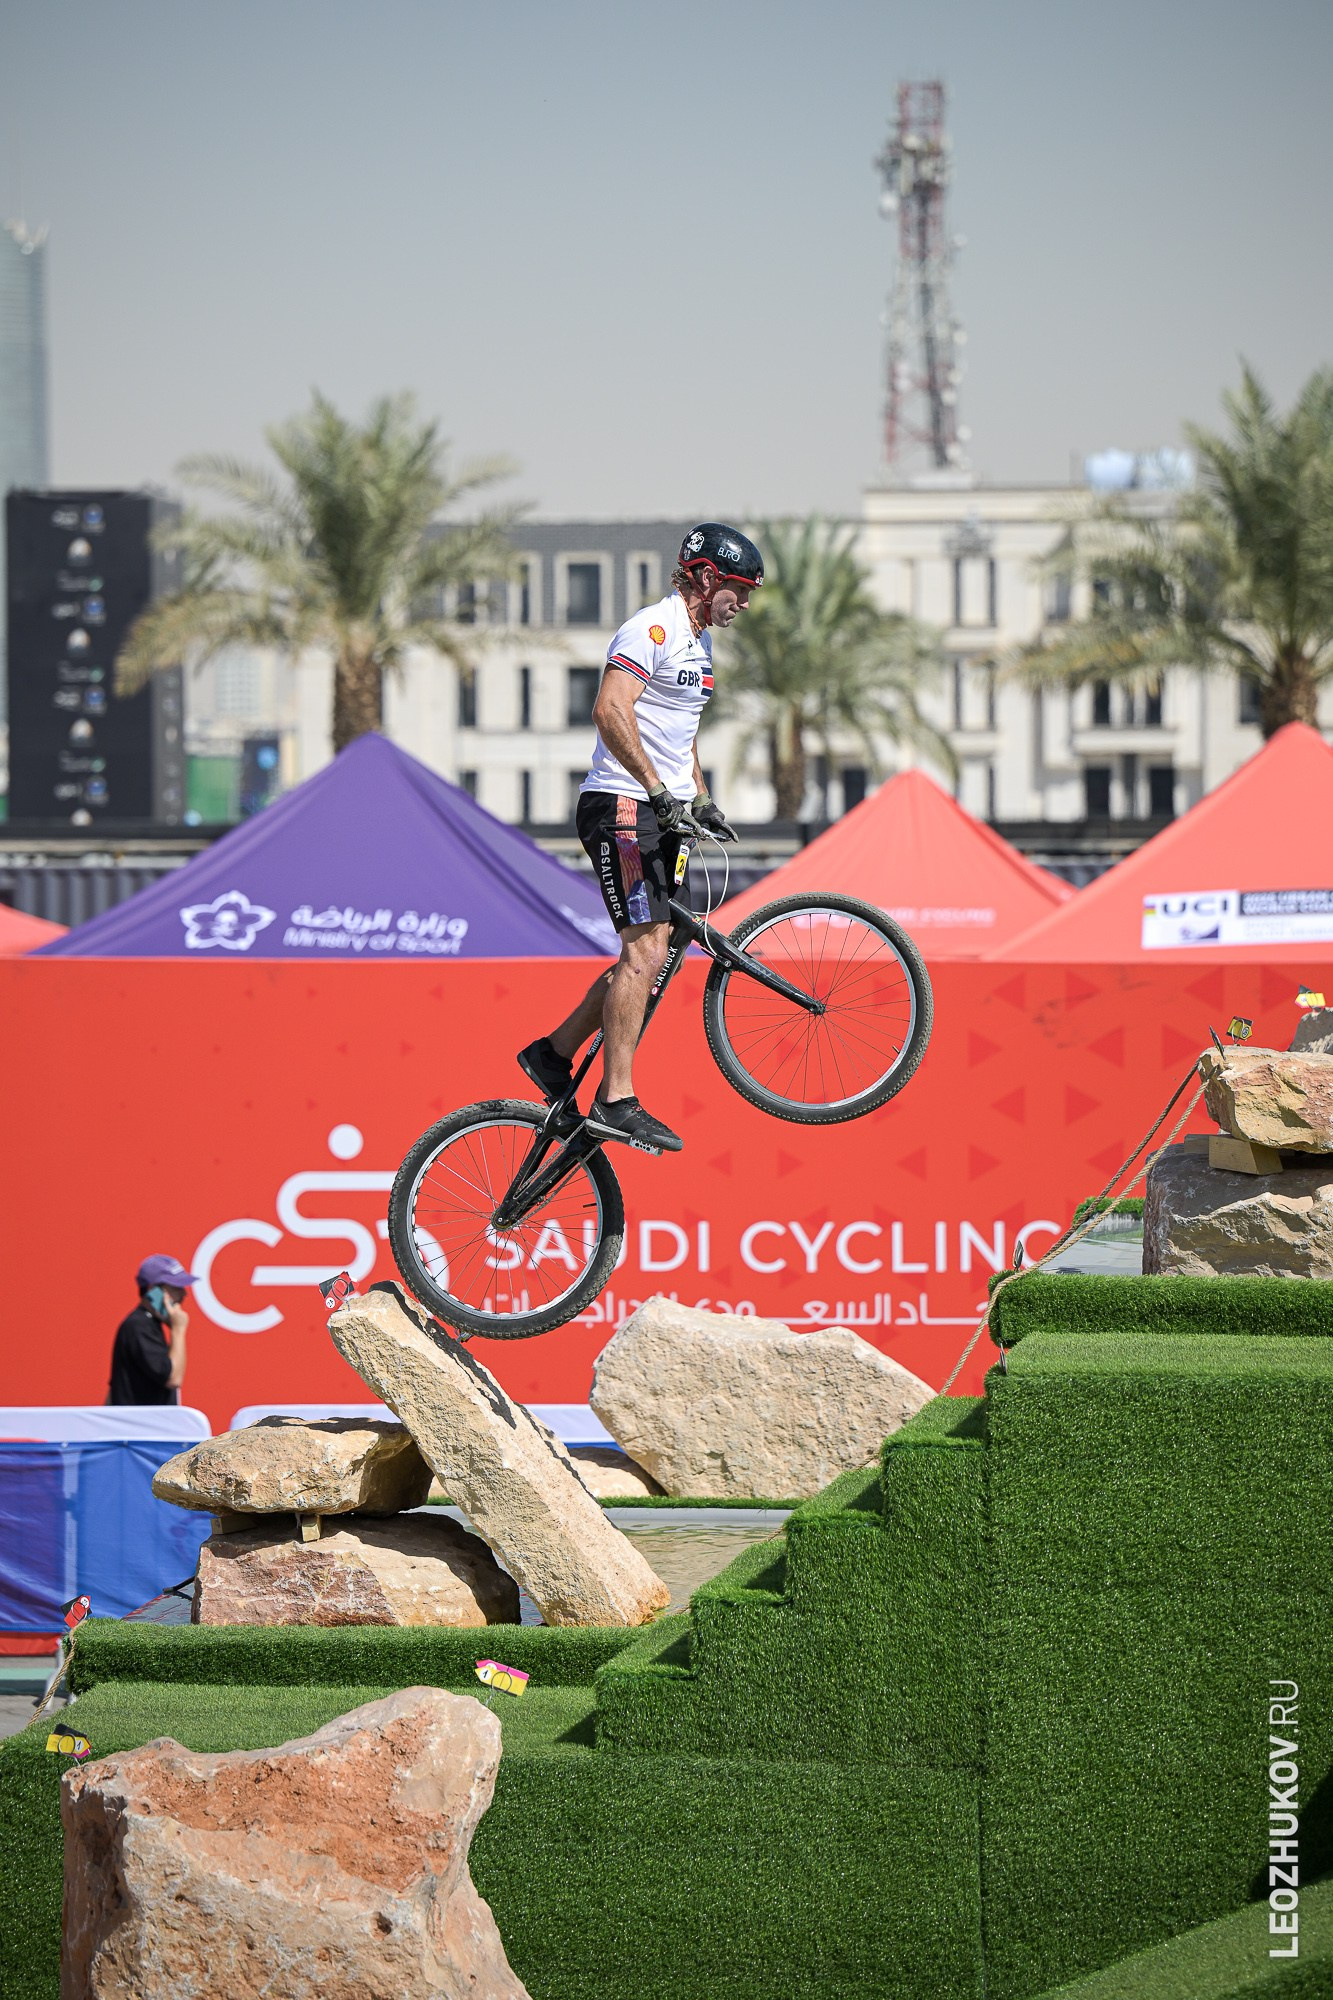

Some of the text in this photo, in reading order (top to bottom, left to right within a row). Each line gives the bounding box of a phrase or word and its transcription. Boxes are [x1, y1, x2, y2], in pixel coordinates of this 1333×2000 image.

[677, 669, 700, 688] GBR
[601, 857, 624, 919] SALTROCK
[1163, 898, 1228, 917] UCI
